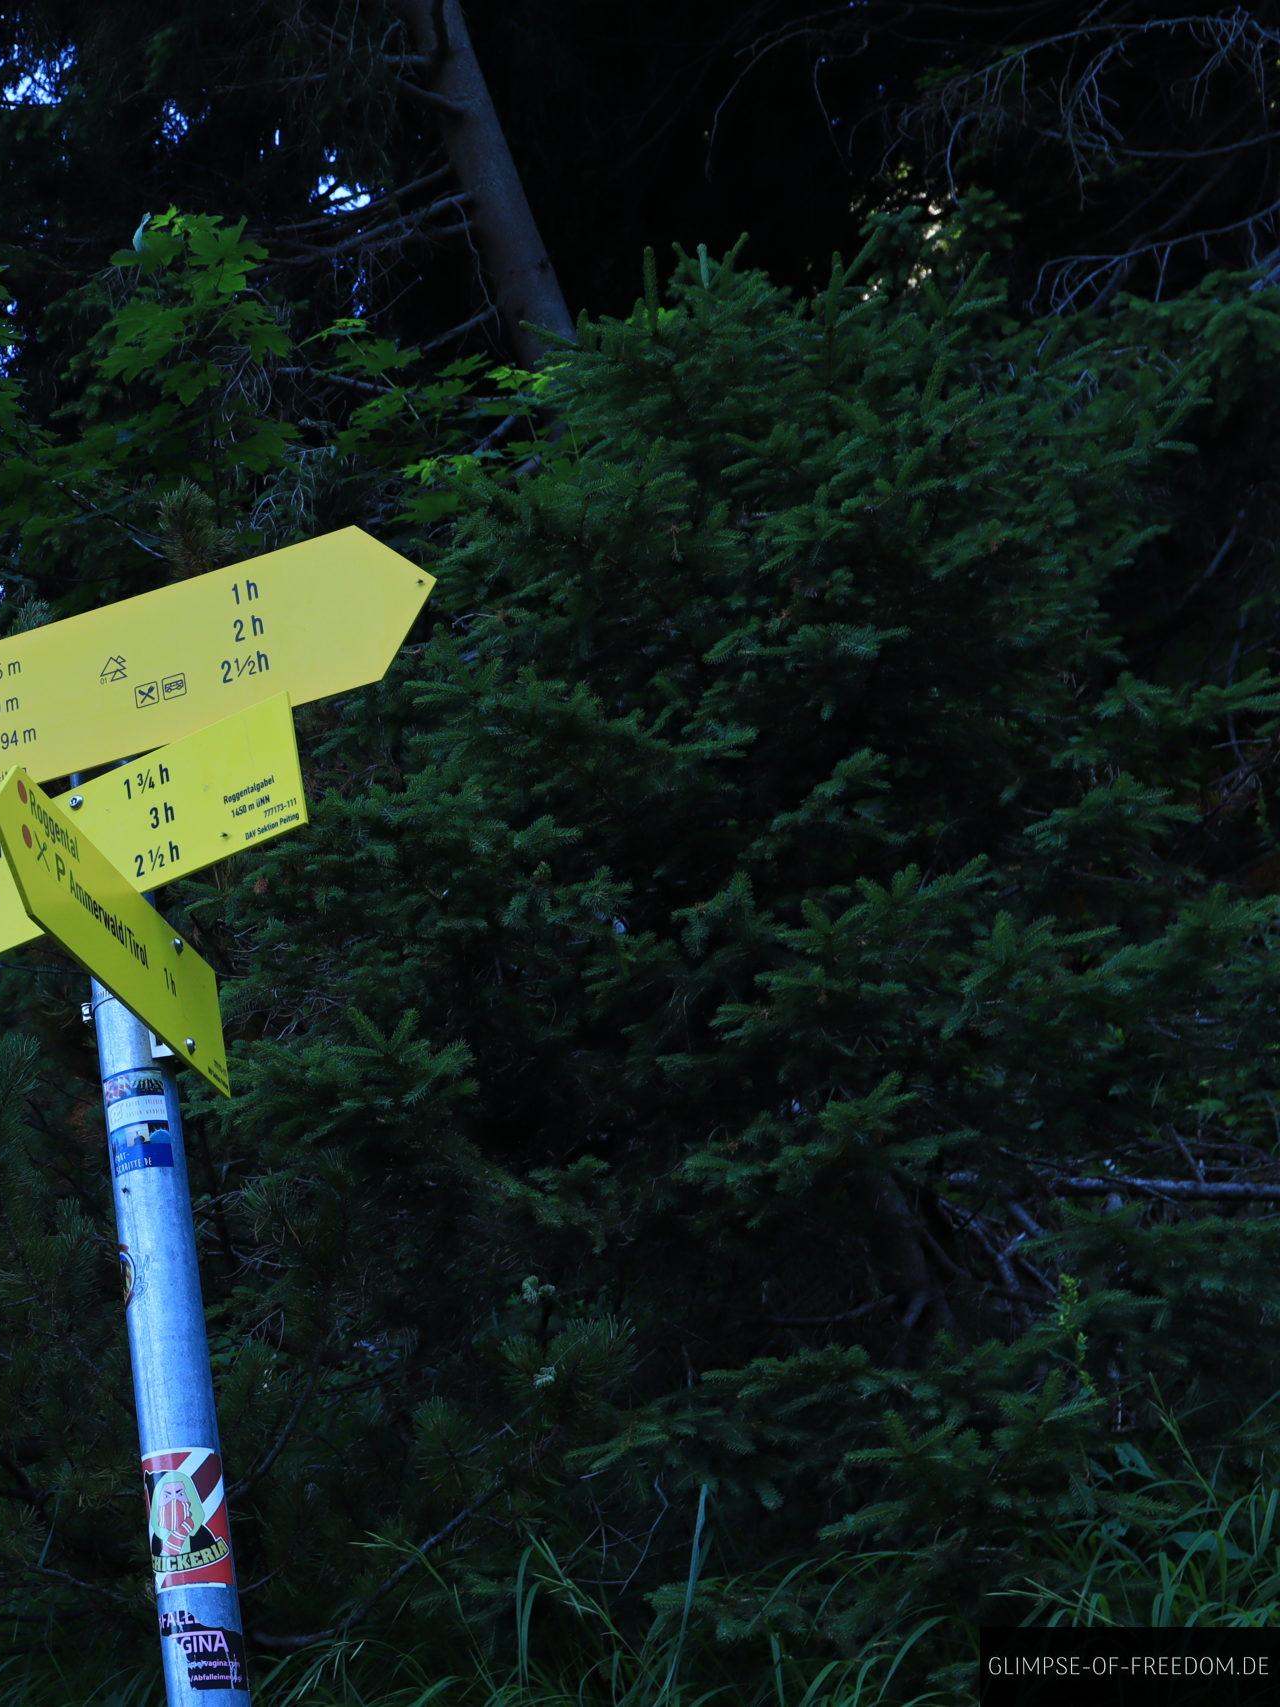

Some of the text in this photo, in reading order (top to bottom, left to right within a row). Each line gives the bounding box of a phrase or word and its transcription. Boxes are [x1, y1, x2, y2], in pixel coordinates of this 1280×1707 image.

[231, 579, 259, 605] 1 h
[233, 614, 264, 642] 2 h
[8, 659, 22, 676] m
[5, 696, 20, 714] m
[23, 727, 37, 745] m
[223, 775, 275, 804] Roggentalgabel
[149, 801, 176, 830] 3 h
[248, 803, 256, 814] m
[29, 789, 80, 863] Roggental
[257, 821, 279, 835] Sektion
[70, 869, 149, 970] Ammerwald/Tirol
